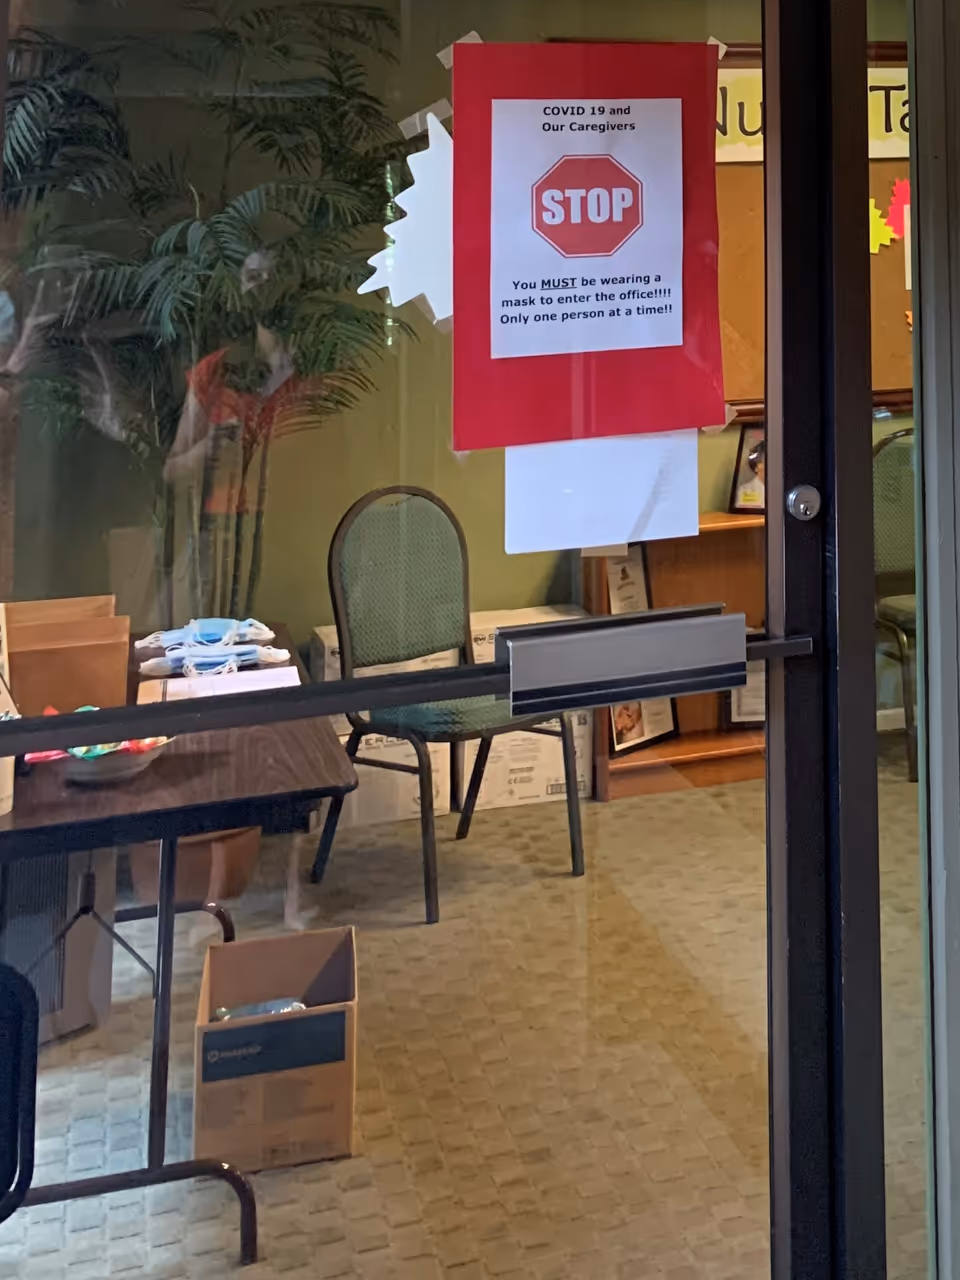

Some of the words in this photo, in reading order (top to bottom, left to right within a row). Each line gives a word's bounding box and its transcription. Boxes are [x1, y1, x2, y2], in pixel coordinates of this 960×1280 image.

[542, 105, 586, 116] COVID
[590, 105, 605, 116] 19
[608, 105, 631, 116] and
[542, 122, 566, 132] Our
[569, 121, 636, 133] Caregivers
[540, 187, 634, 225] STOP
[512, 280, 537, 290] You
[540, 277, 578, 290] MUST
[580, 276, 597, 287] be
[600, 273, 651, 286] wearing
[654, 274, 662, 283] a
[501, 296, 536, 308] mask
[540, 296, 554, 306] to
[557, 293, 592, 304] enter
[595, 291, 616, 302] the
[619, 288, 672, 301] office!!!!
[500, 312, 529, 325] Only
[533, 312, 558, 323] one
[561, 310, 605, 322] person
[608, 307, 622, 317] at
[624, 308, 632, 317] a
[636, 304, 673, 316] time!!
